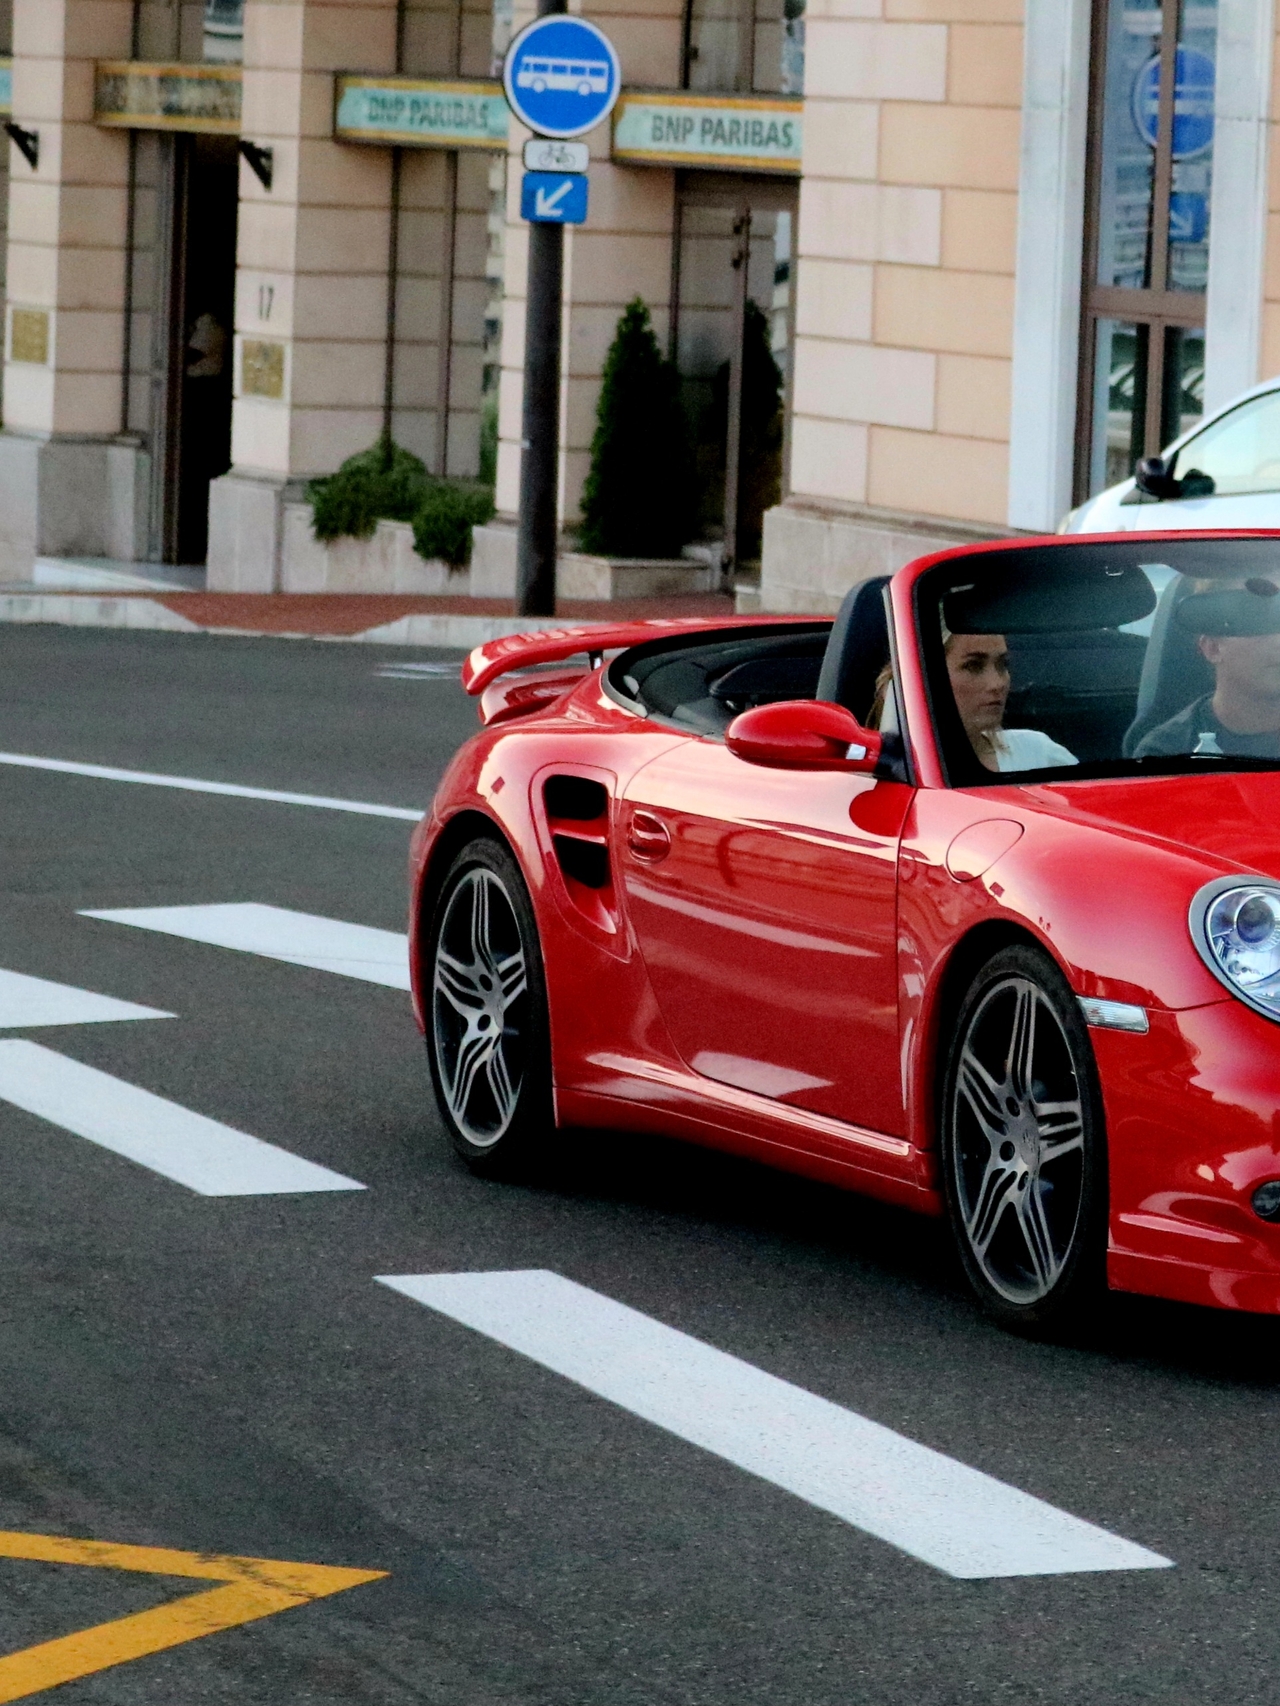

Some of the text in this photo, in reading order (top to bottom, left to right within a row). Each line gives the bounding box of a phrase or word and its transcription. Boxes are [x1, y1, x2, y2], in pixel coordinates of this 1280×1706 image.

[651, 114, 794, 149] BNP PARIBAS
[259, 285, 275, 321] 17
